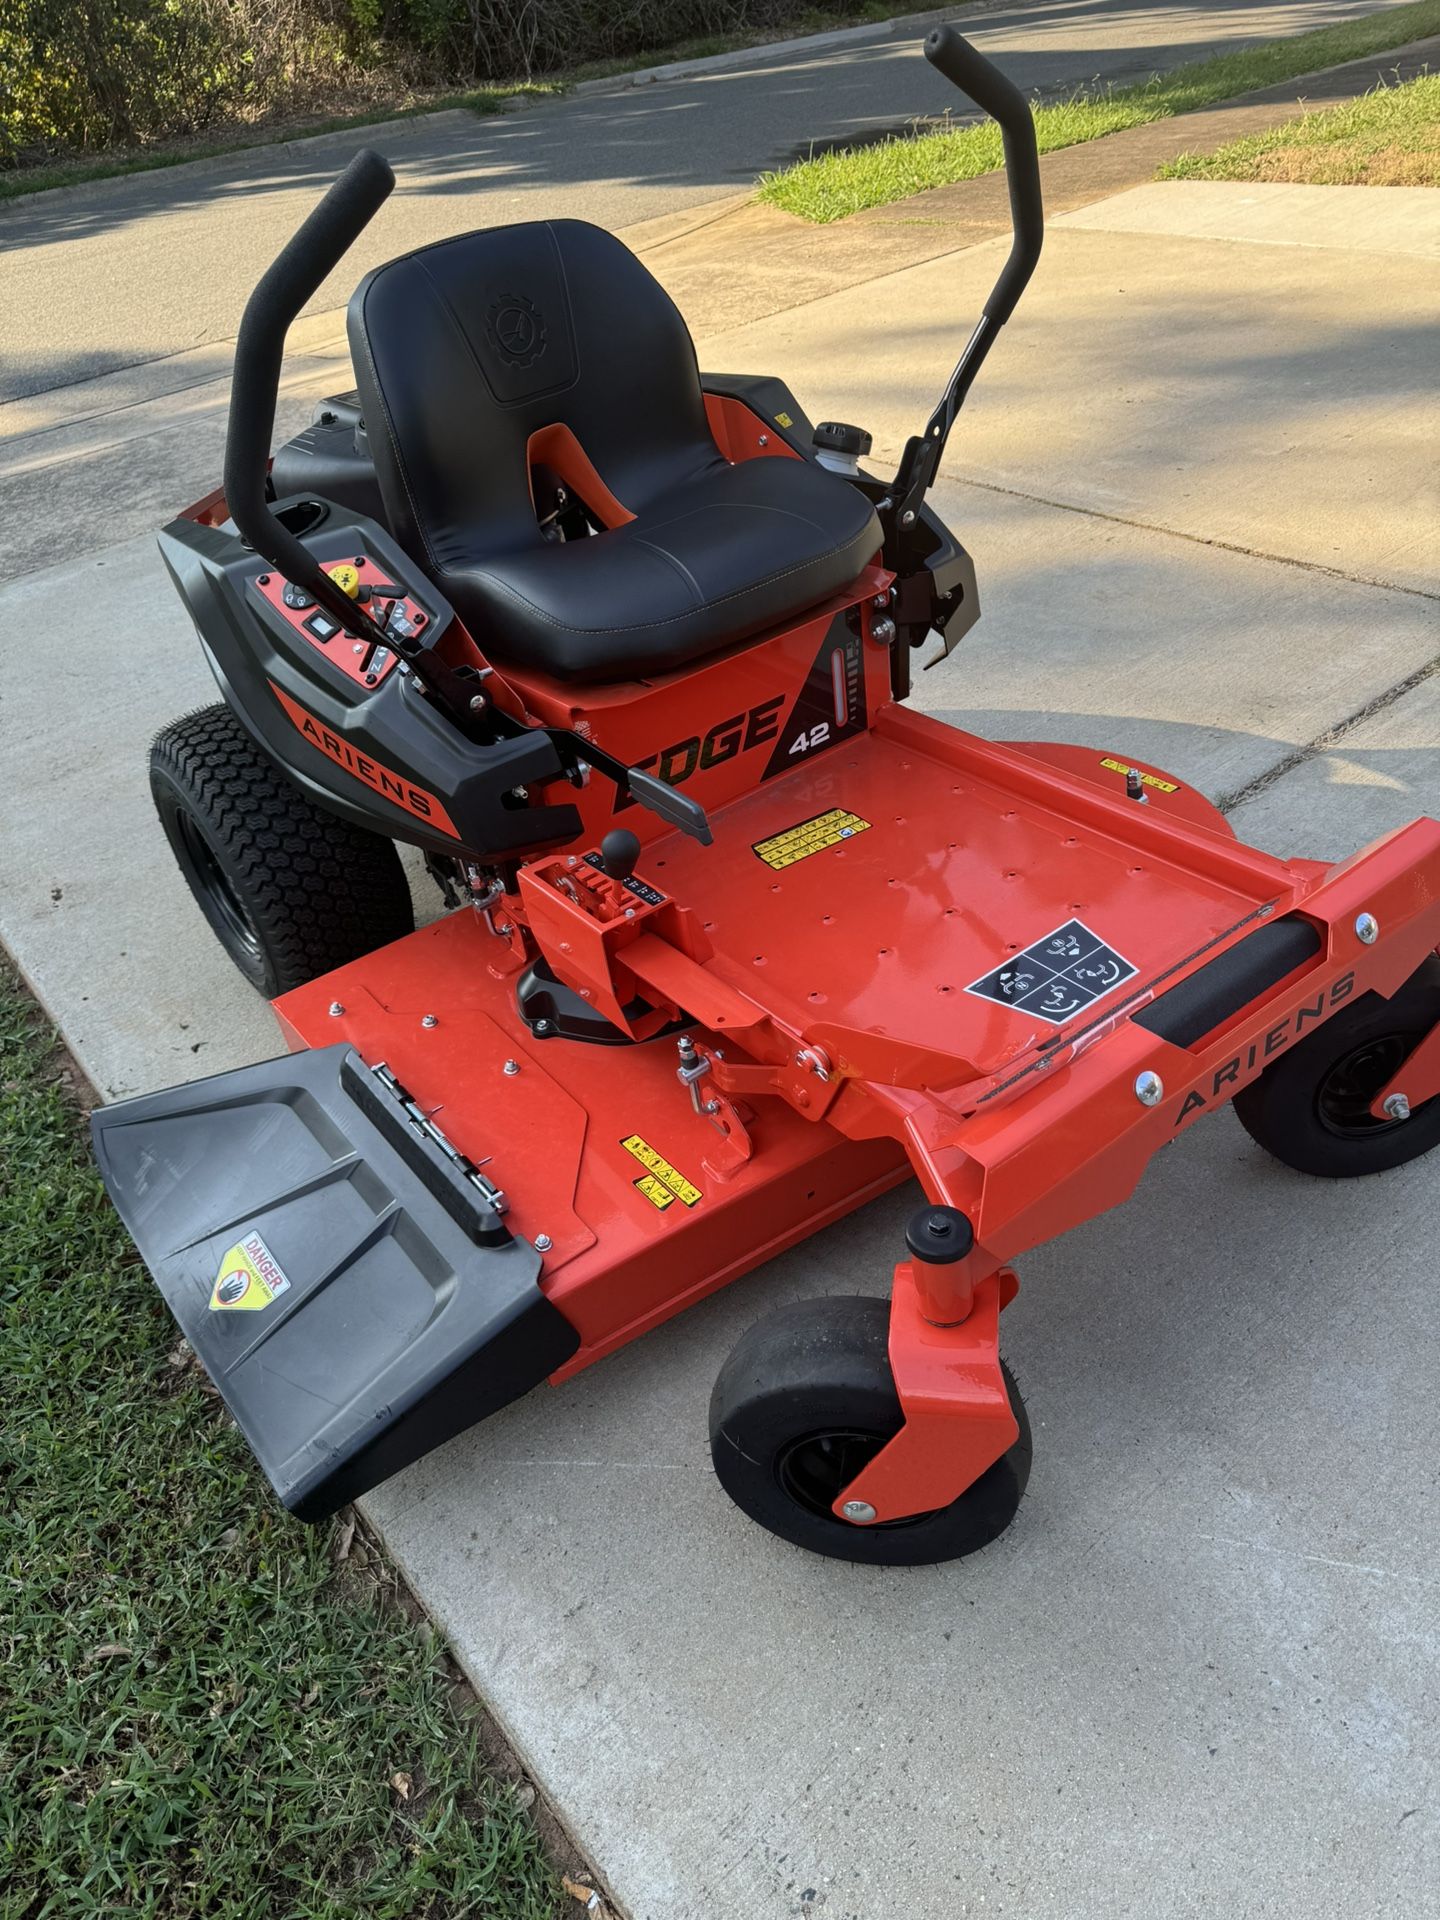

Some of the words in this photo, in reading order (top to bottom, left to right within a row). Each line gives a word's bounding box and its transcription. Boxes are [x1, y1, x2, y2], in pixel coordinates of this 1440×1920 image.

[302, 718, 432, 817] ARIENS
[788, 721, 830, 756] 42
[1174, 971, 1355, 1127] ARIENS
[245, 1238, 284, 1291] DANGER
